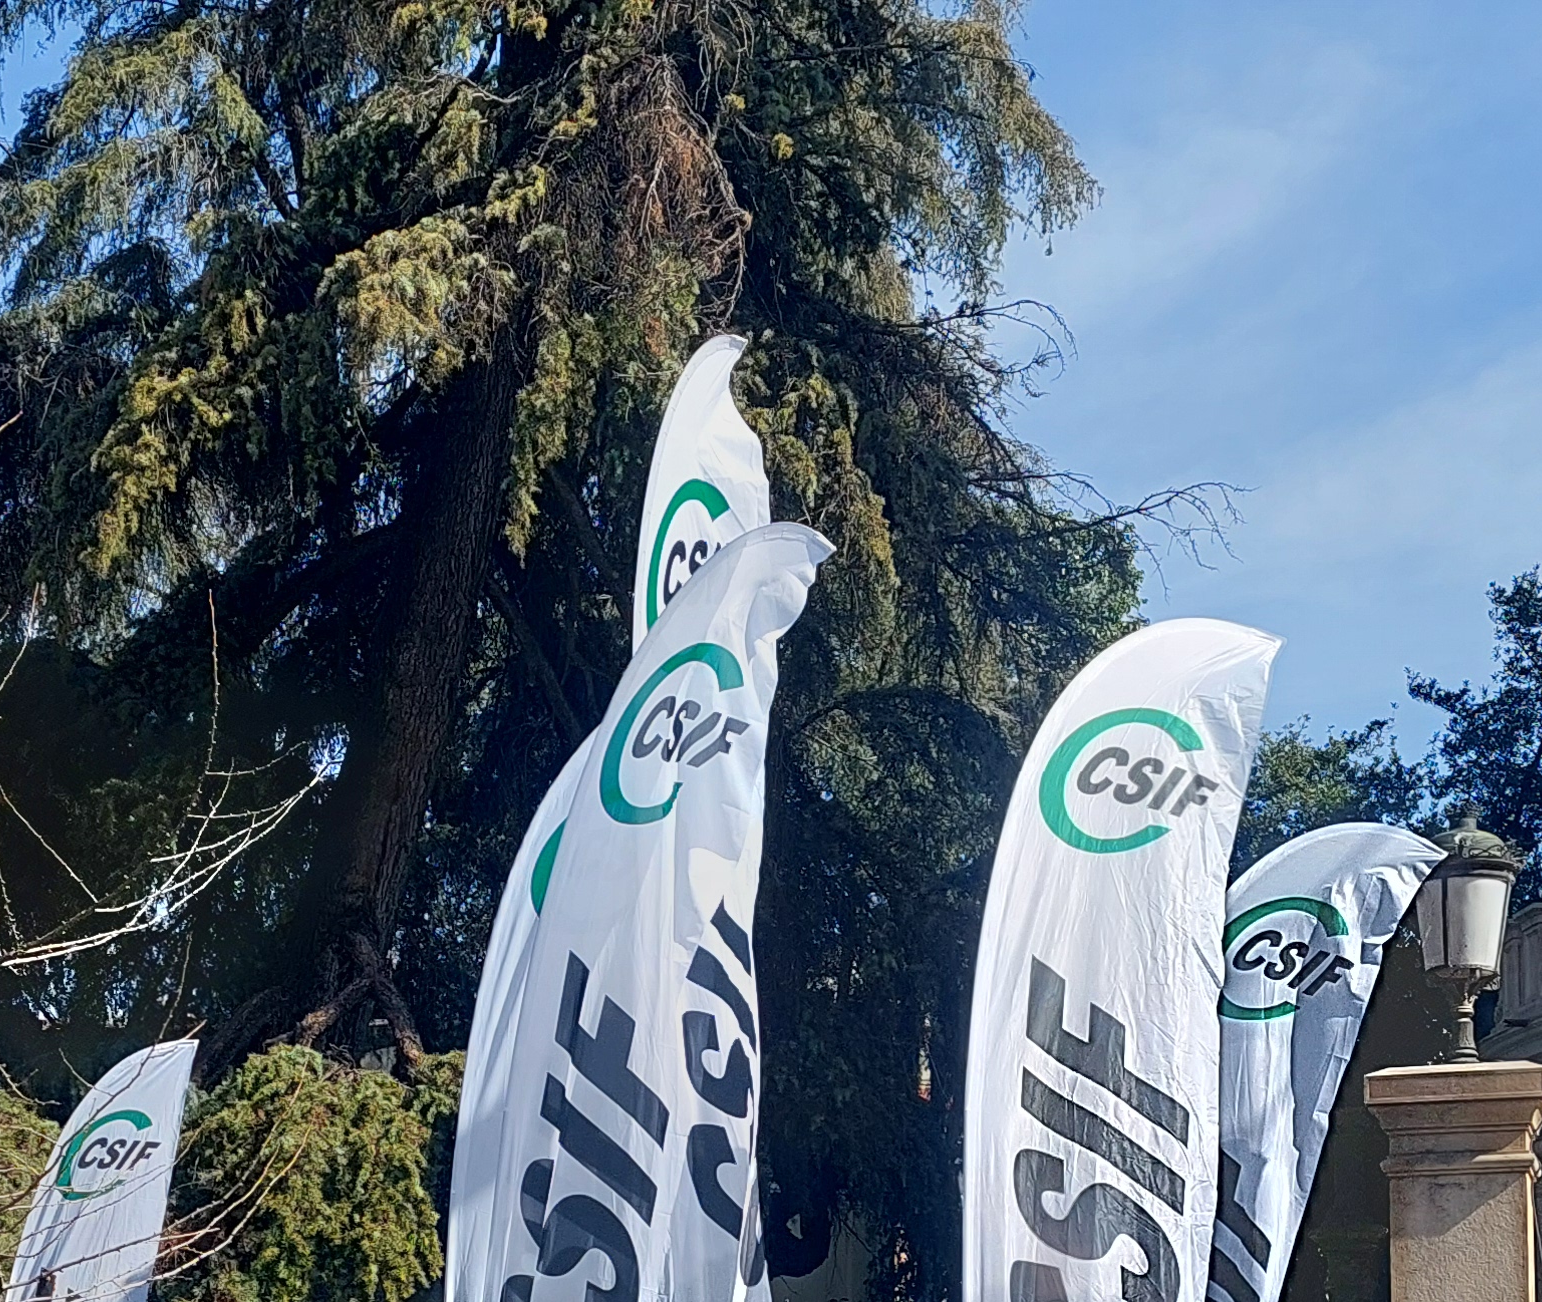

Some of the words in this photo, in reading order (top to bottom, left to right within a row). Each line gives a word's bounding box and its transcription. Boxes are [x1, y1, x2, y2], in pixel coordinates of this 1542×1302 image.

[632, 696, 751, 768] CSIF
[1076, 746, 1219, 819] CSIF
[1233, 930, 1355, 996] CSIF
[77, 1136, 161, 1171] CSIF
